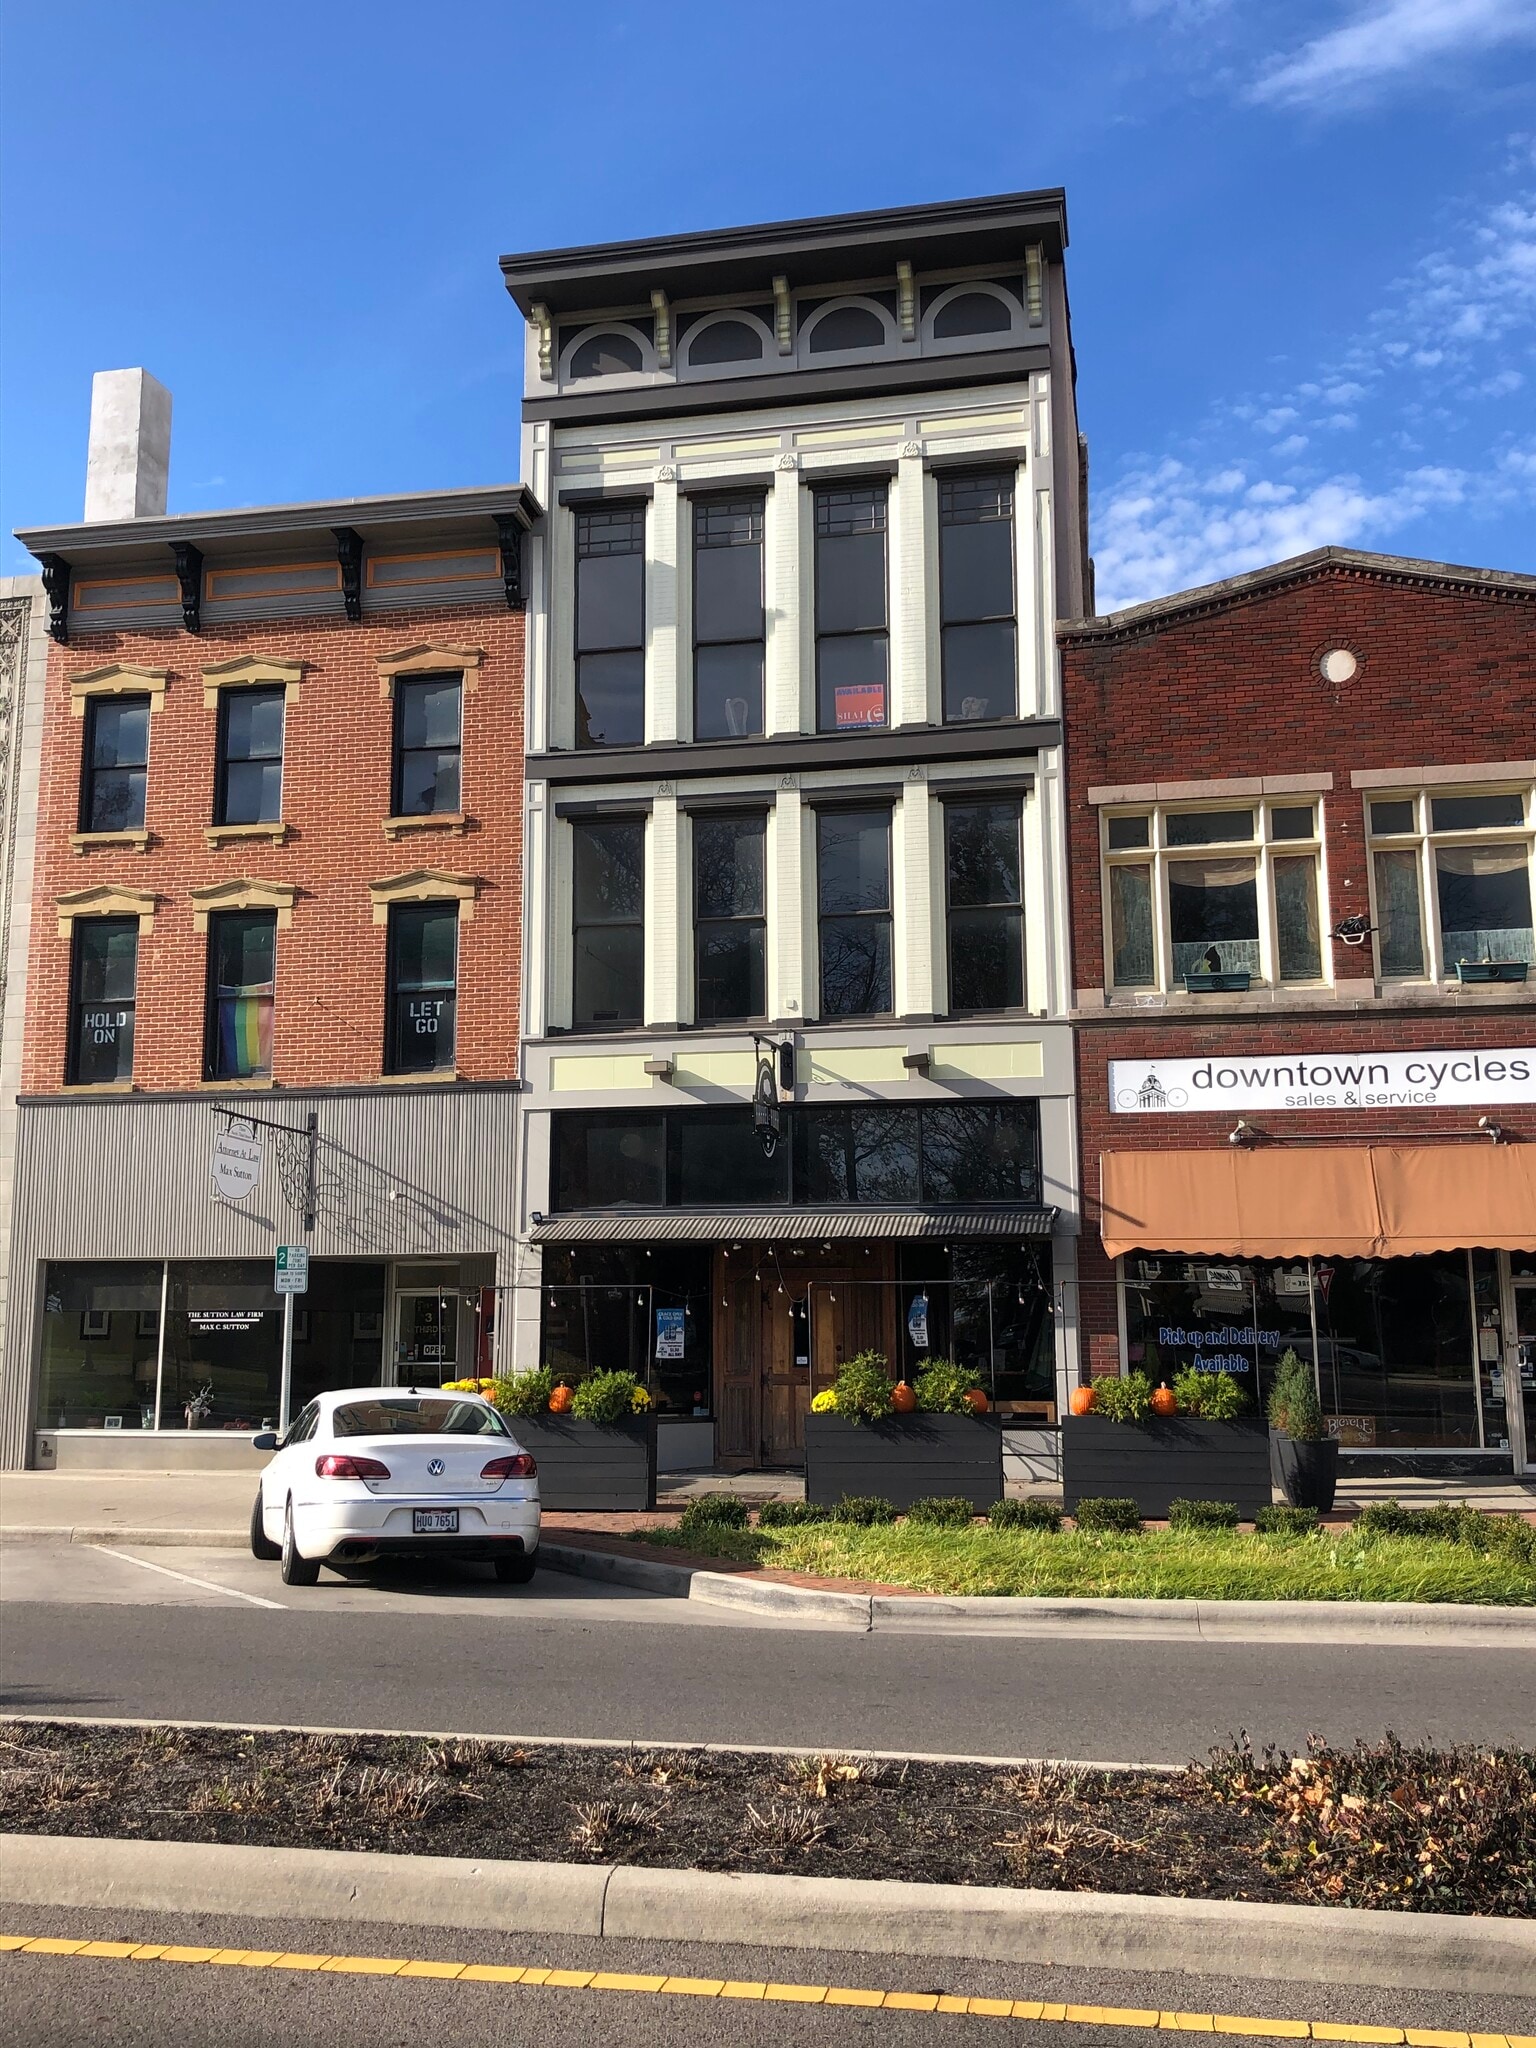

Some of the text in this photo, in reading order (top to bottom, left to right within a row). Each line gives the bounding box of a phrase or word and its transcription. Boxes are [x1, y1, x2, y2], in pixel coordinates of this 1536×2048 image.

[409, 1000, 444, 1017] LET
[84, 1011, 127, 1028] HOLD
[415, 1018, 438, 1034] GO
[93, 1028, 116, 1044] ON
[1191, 1055, 1531, 1090] downtown cycles
[1285, 1089, 1437, 1107] sales & service
[219, 1162, 253, 1180] Max Sutton
[278, 1252, 286, 1264] 2
[424, 1312, 433, 1323] 3
[1159, 1327, 1280, 1349] Pick up and Delivery
[425, 1346, 445, 1354] OPEN
[1194, 1354, 1249, 1373] Available
[1327, 1417, 1373, 1434] BICYCLE
[435, 1515, 455, 1527] 7651
